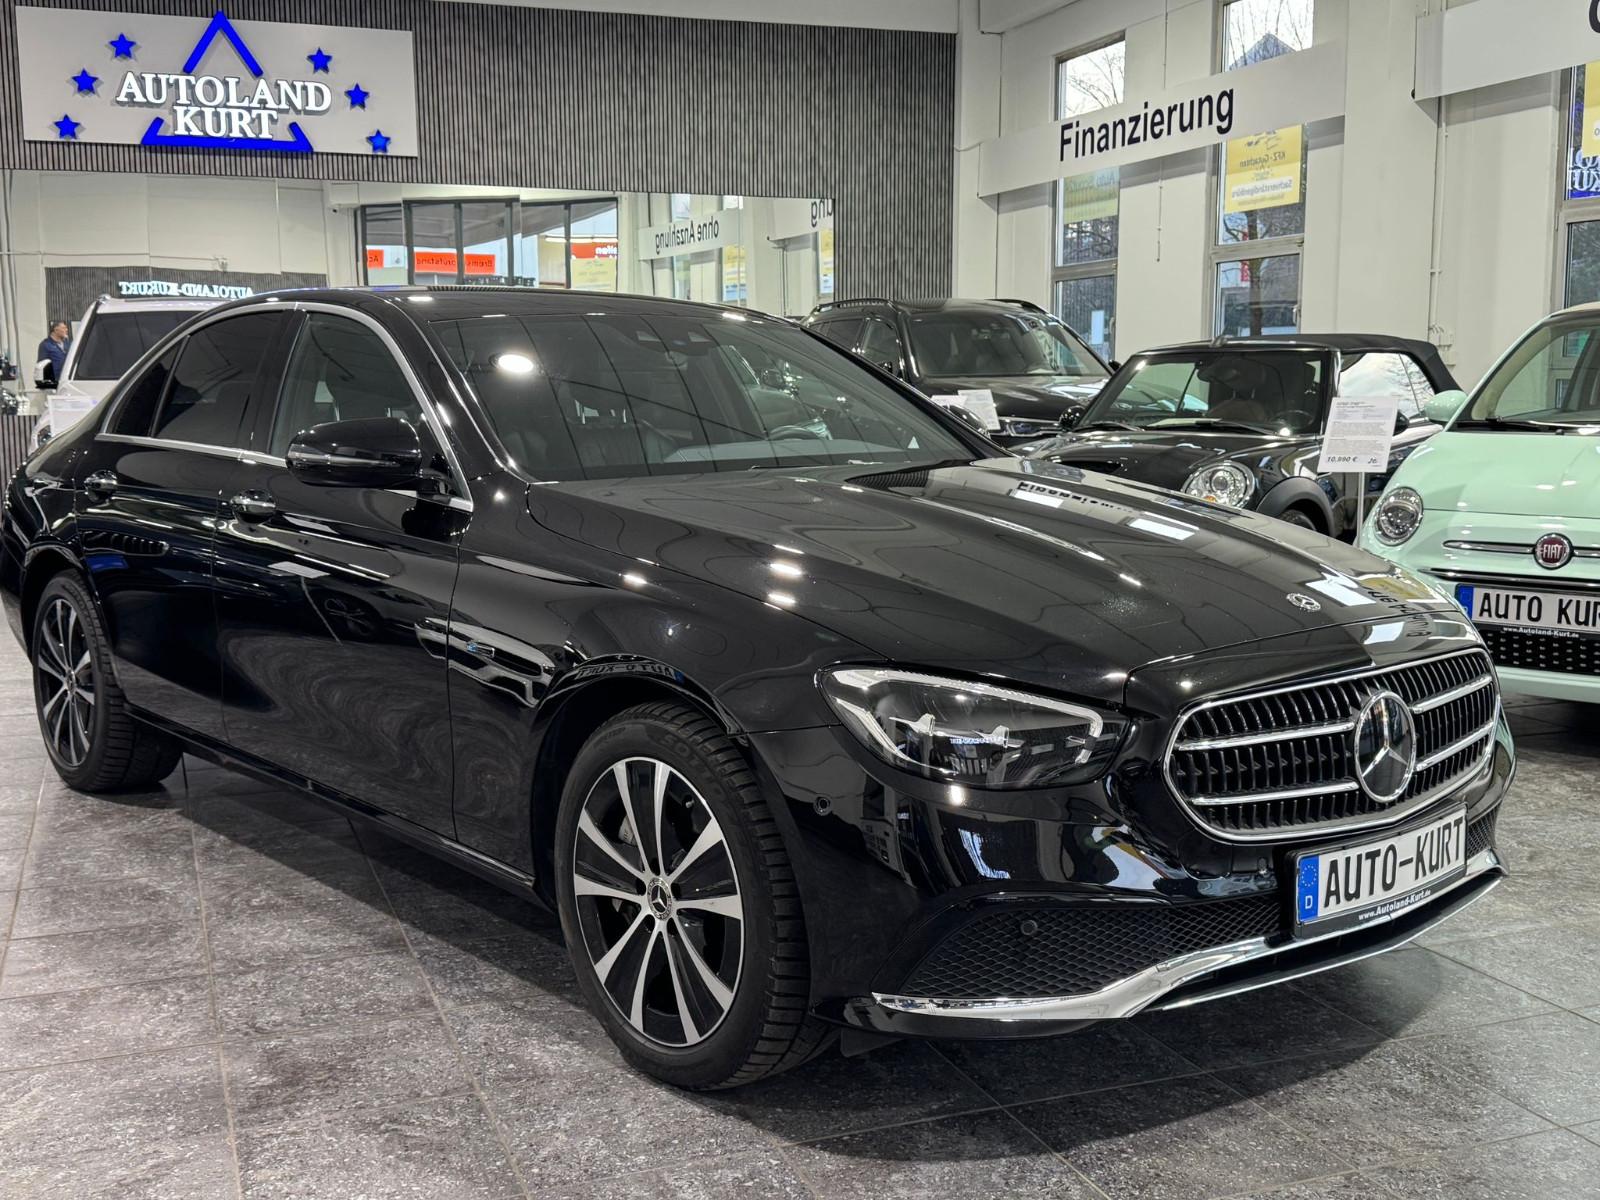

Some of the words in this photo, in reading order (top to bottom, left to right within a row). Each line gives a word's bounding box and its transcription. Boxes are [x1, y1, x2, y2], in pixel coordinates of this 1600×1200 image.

[116, 71, 332, 112] AUTOLAND
[173, 105, 278, 139] KURT
[1059, 88, 1235, 162] Finanzierung
[1542, 543, 1563, 559] FIAT
[1478, 592, 1543, 623] AUTO
[1502, 626, 1580, 637] www.Autoland-Kurt.de
[1304, 895, 1314, 910] D
[1323, 816, 1464, 908] AUTO-KURT
[1358, 888, 1432, 921] www.Autoland-Kurt.de
